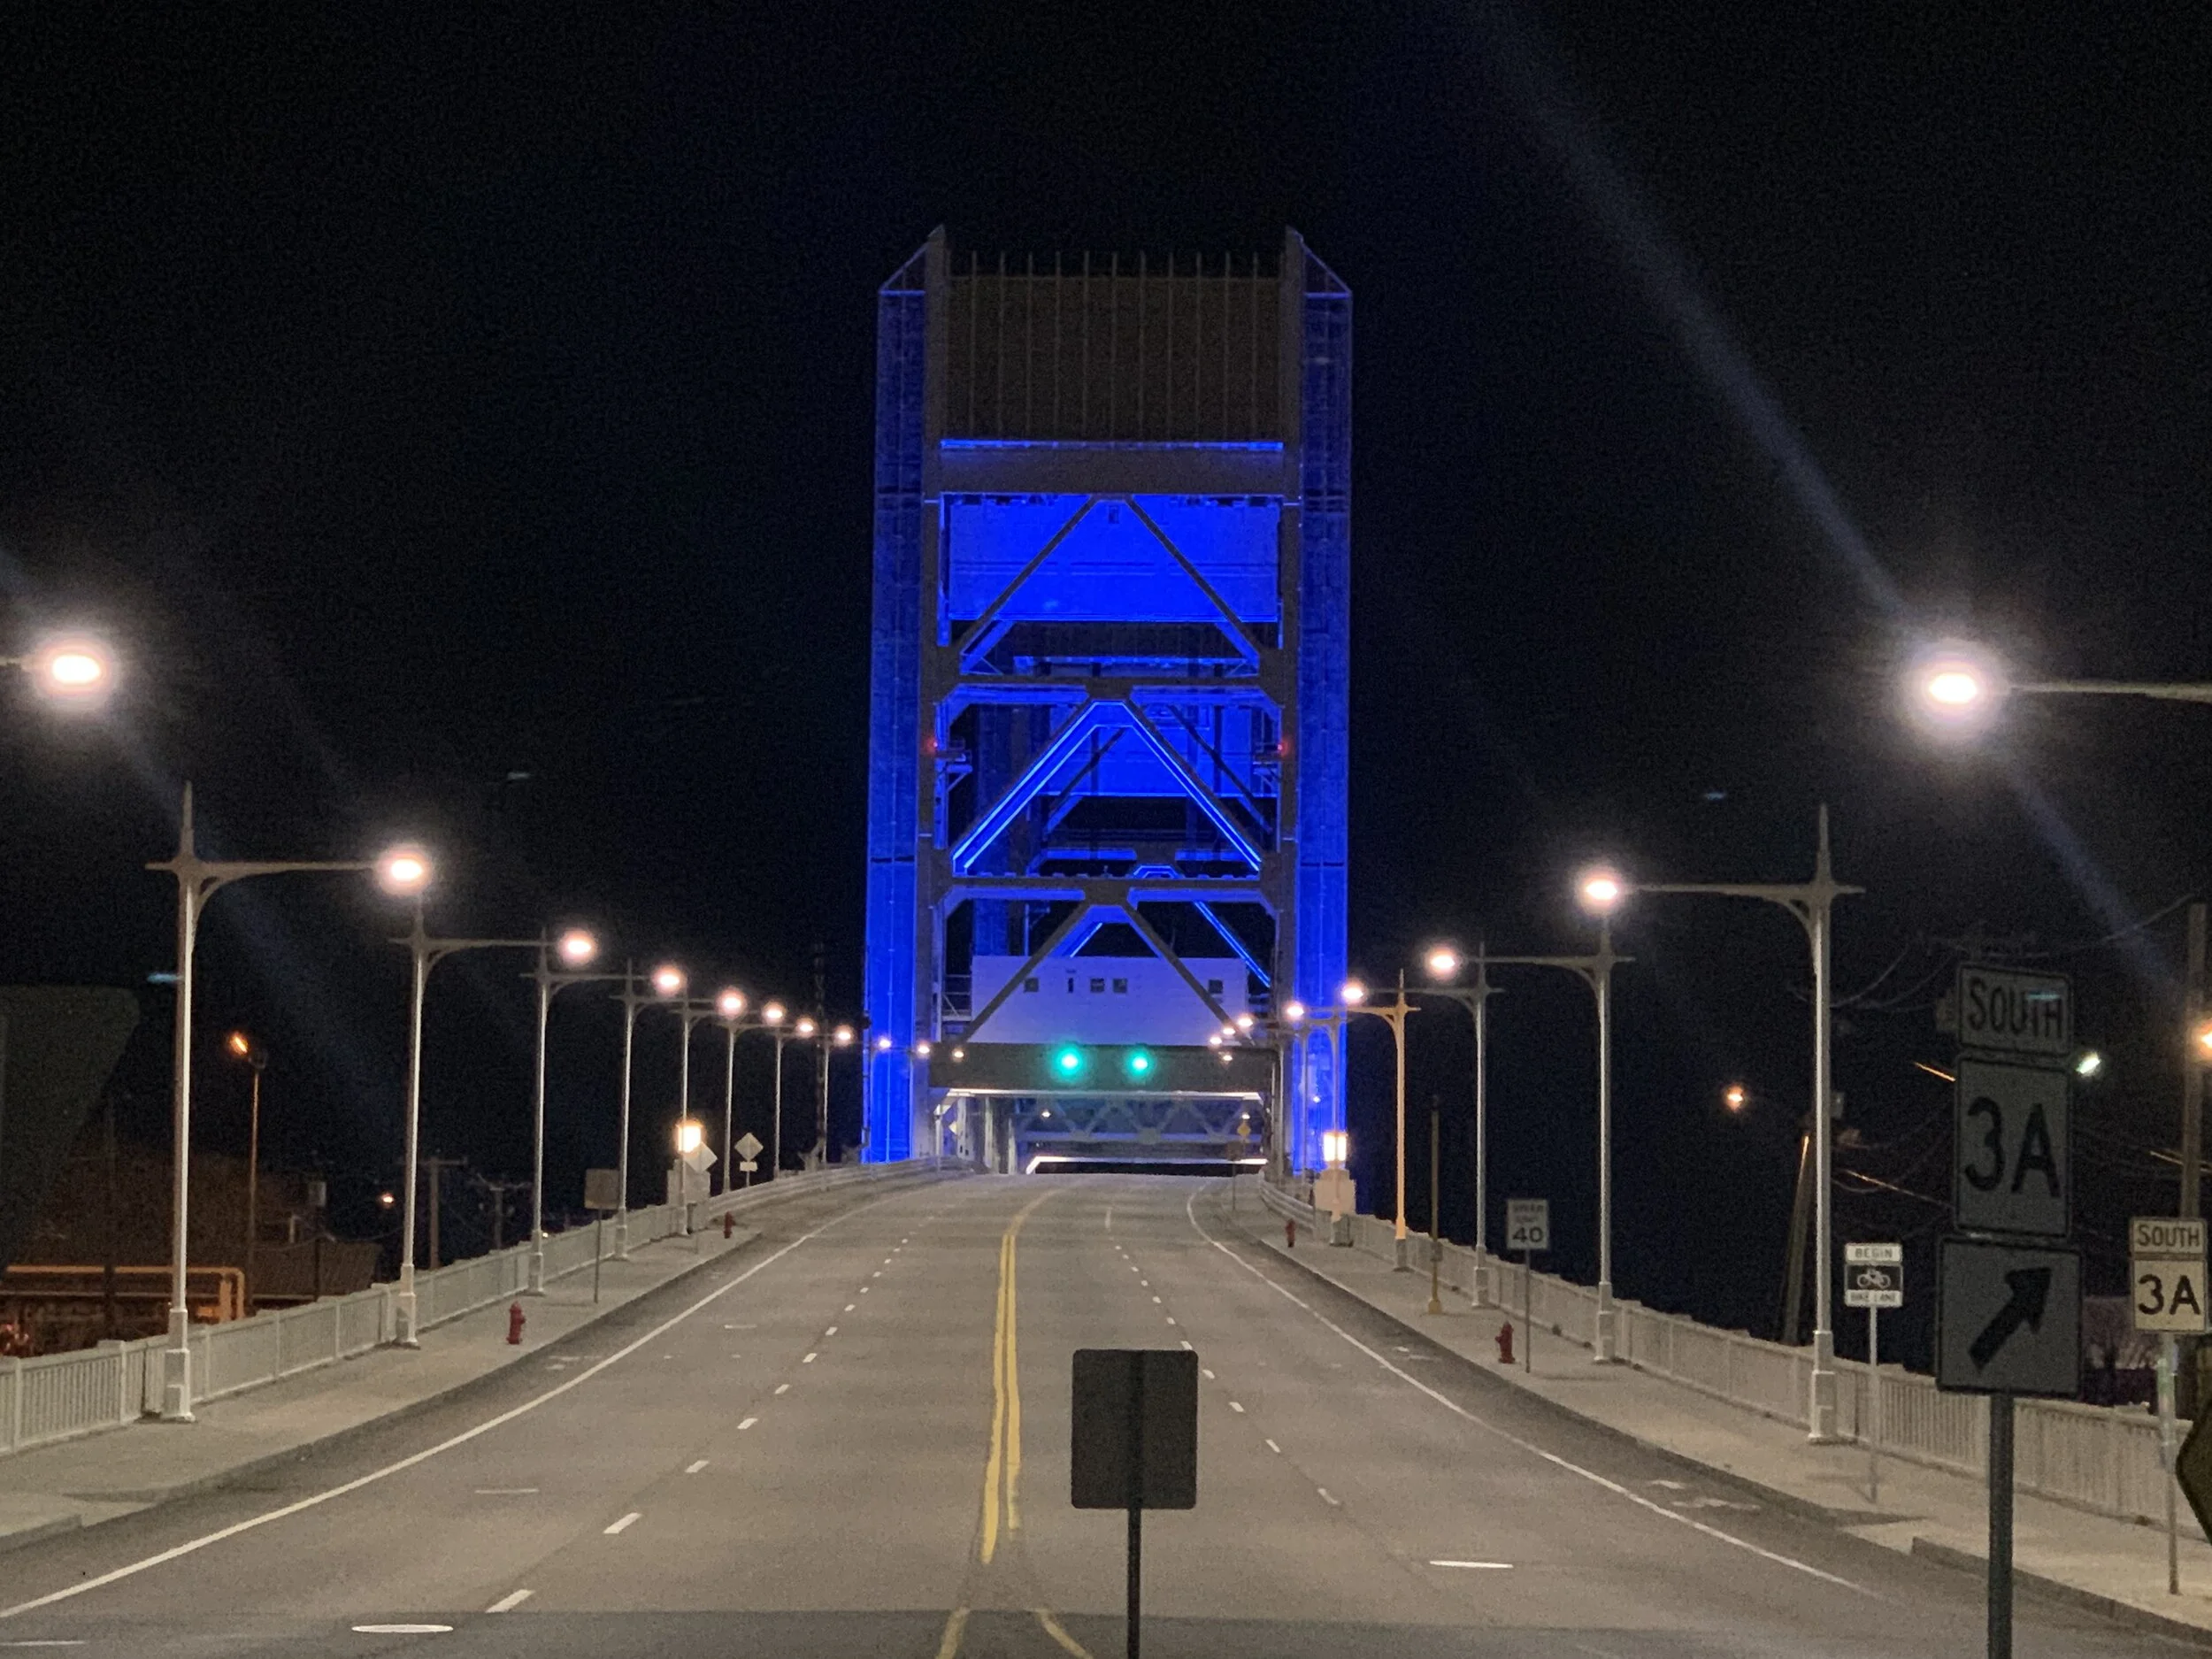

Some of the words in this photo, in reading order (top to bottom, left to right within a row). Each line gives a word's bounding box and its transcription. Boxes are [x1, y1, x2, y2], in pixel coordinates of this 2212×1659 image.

[1968, 976, 2062, 1039] SOUTH
[1964, 1096, 2061, 1197] 3A
[1512, 1226, 1545, 1243] 40
[2137, 1224, 2200, 1248] SOUTH
[1855, 1248, 1893, 1258] BEGIN
[2138, 1273, 2201, 1316] 3A
